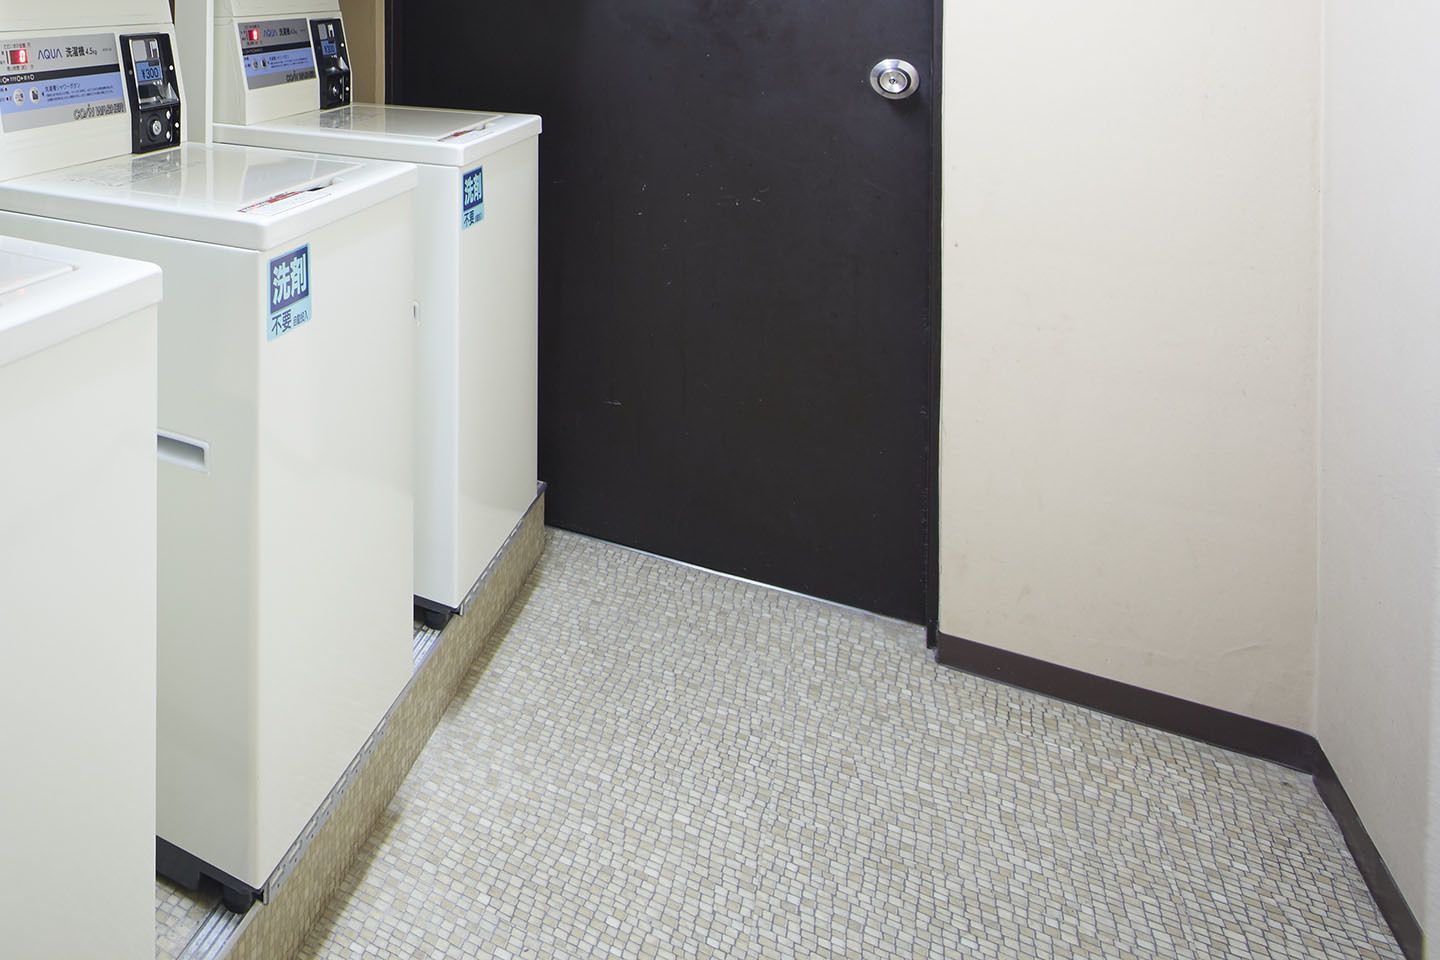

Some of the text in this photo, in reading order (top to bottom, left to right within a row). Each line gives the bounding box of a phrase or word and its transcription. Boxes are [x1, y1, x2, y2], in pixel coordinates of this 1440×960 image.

[37, 49, 63, 60] AQUA
[65, 45, 85, 58] 洗濯機
[141, 68, 159, 80] ¥300
[464, 172, 482, 206] 洗剤
[272, 253, 307, 305] 洗剤
[271, 309, 292, 336] 不要
